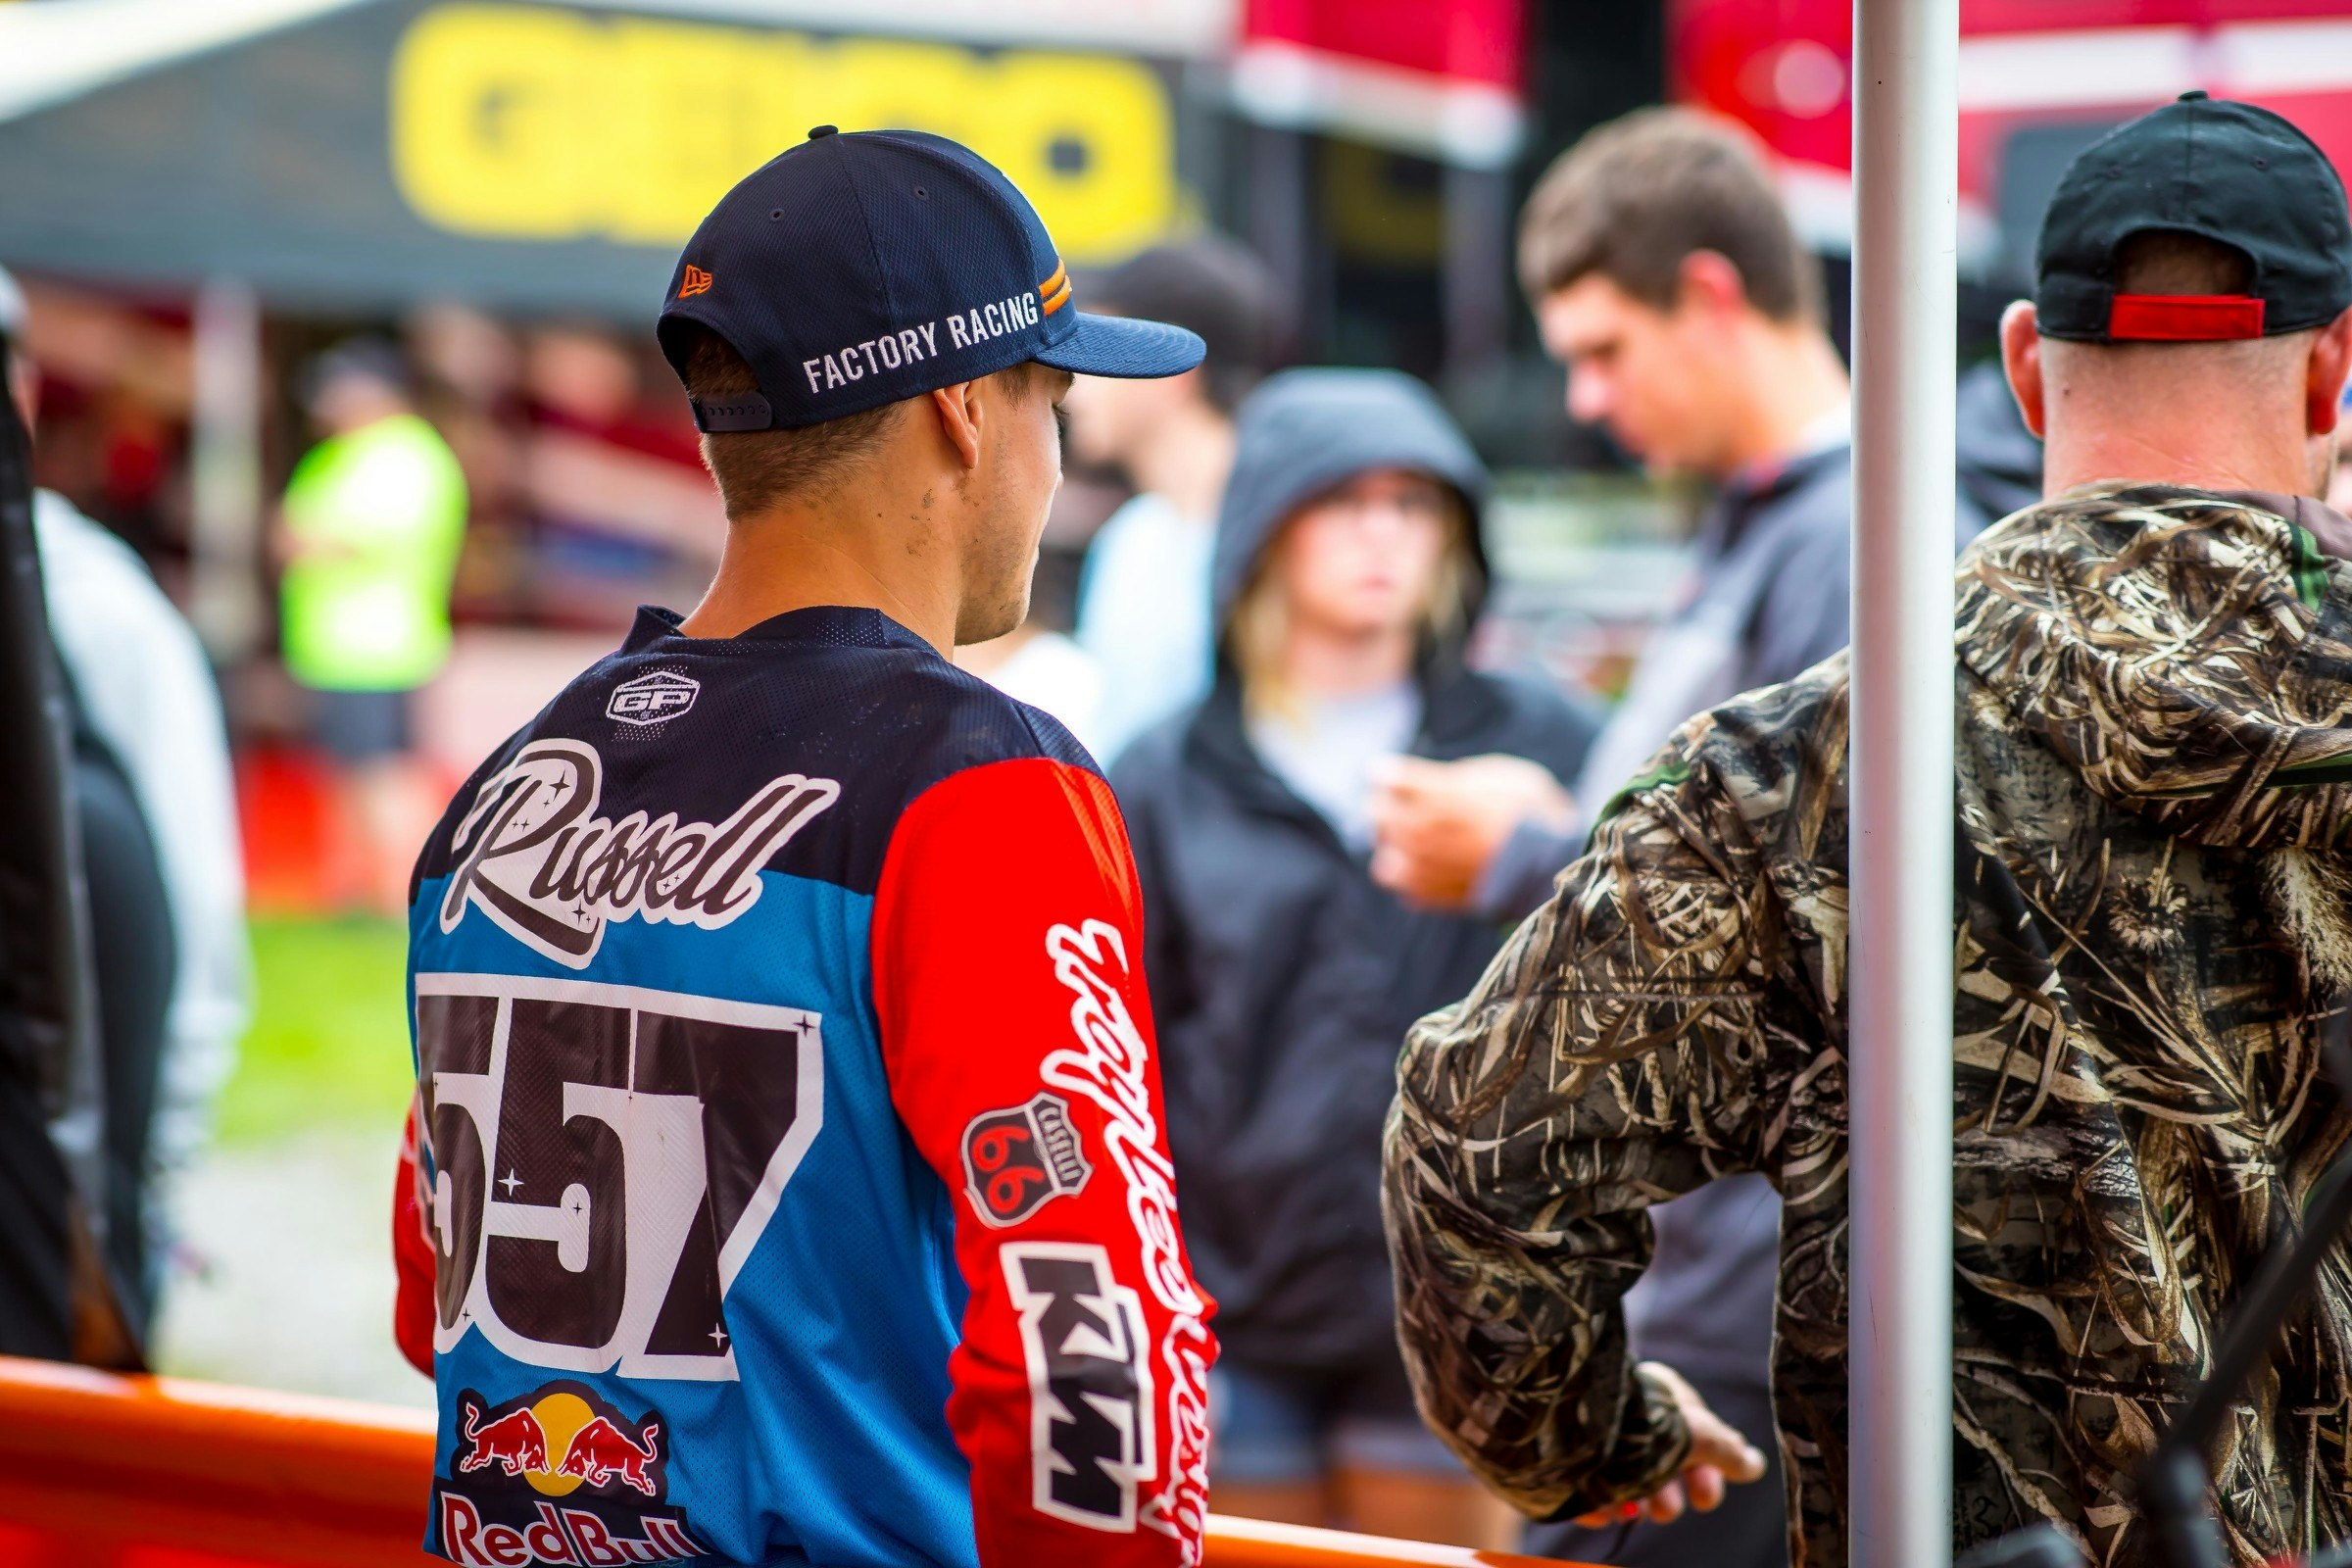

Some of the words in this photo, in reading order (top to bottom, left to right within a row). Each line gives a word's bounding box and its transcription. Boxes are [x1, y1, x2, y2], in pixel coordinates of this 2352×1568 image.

[803, 321, 938, 394] FACTORY
[947, 292, 1039, 350] RACING
[613, 690, 691, 712] GP
[444, 747, 831, 958] Russell
[416, 993, 798, 1356] 557
[972, 1125, 1046, 1215] 66
[1009, 1250, 1149, 1525] KTM
